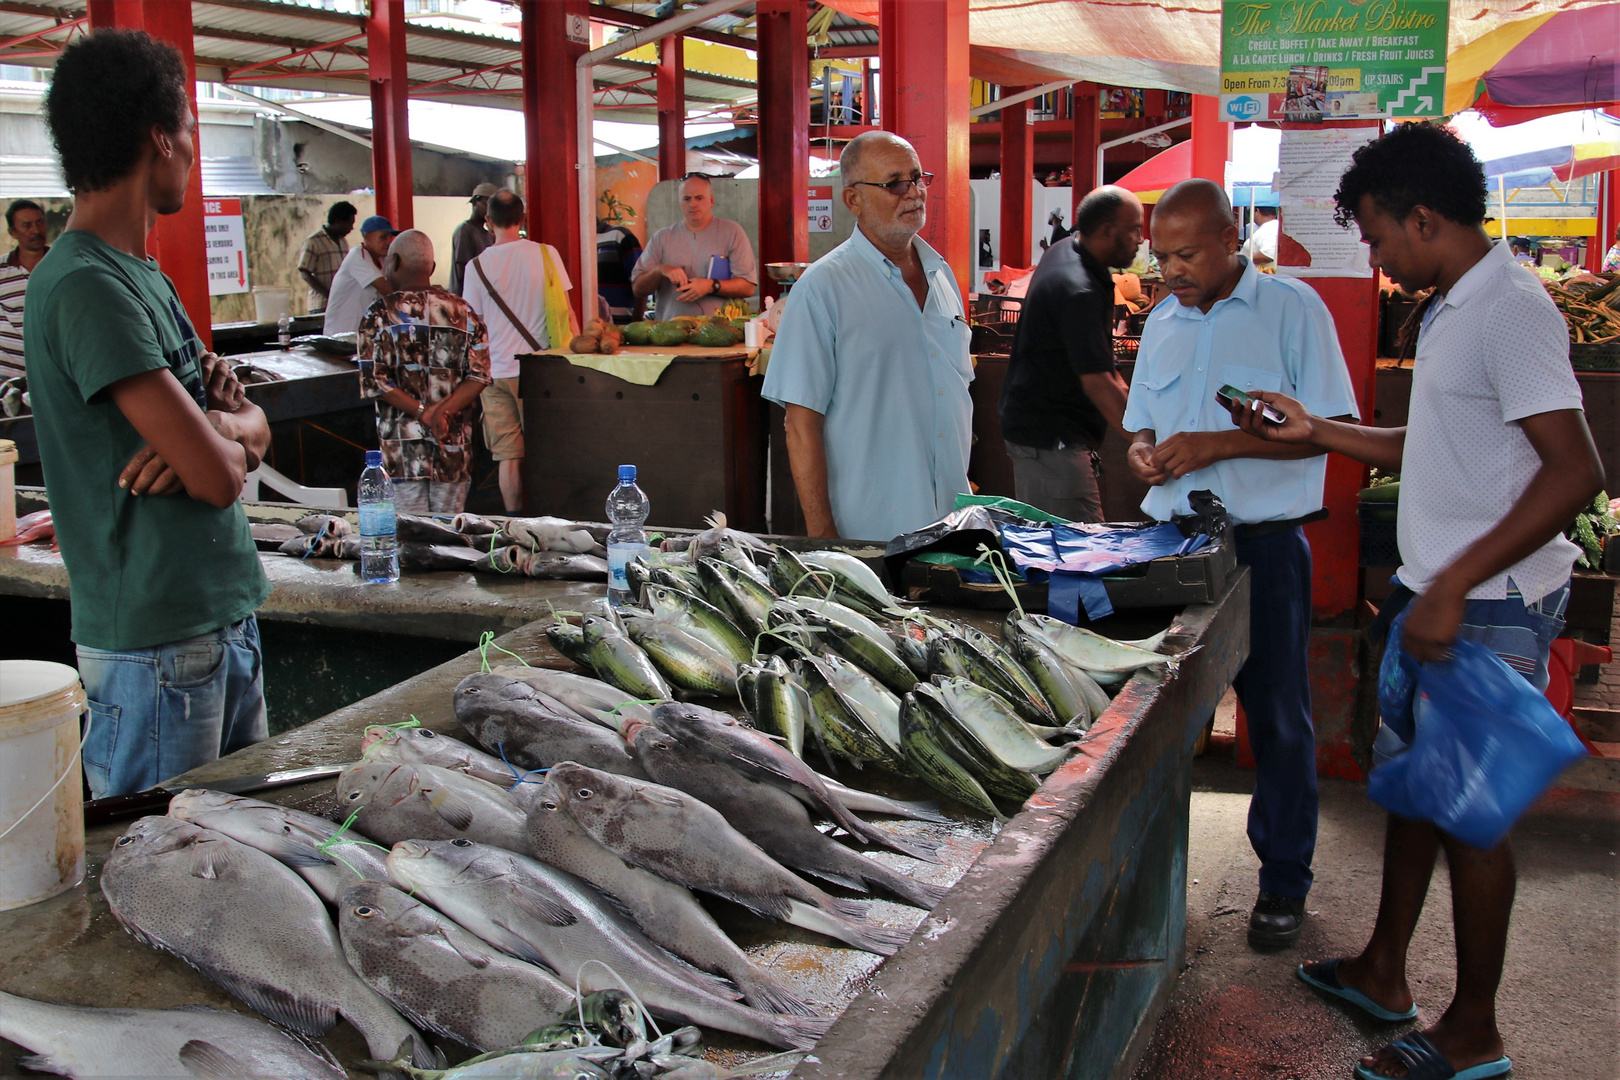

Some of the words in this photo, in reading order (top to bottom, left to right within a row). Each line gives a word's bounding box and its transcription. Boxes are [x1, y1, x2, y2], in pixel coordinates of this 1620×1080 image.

[1231, 3, 1272, 36] The
[1276, 0, 1359, 34] Market
[1365, 0, 1437, 31] Bistro
[1248, 40, 1278, 51] CREOLE
[1280, 39, 1309, 50] BUFFET
[1317, 37, 1337, 48] TAKE
[1339, 37, 1364, 48] AWAY
[1372, 35, 1419, 47] BREAKFAST
[1233, 54, 1239, 65] A
[1252, 53, 1277, 64] CARTE
[1279, 52, 1305, 63] LUNCH
[1313, 51, 1343, 62] DRINKS
[1352, 50, 1377, 61] FRESH
[1379, 49, 1403, 60] FRUIT
[1405, 48, 1435, 60] JUICES
[1224, 78, 1246, 91] Open
[1248, 77, 1270, 89] From
[1364, 74, 1376, 85] UP
[1377, 73, 1404, 85] STAIRS
[218, 224, 229, 232] ONLY
[212, 239, 233, 248] VENDORS
[227, 270, 238, 278] AREA
